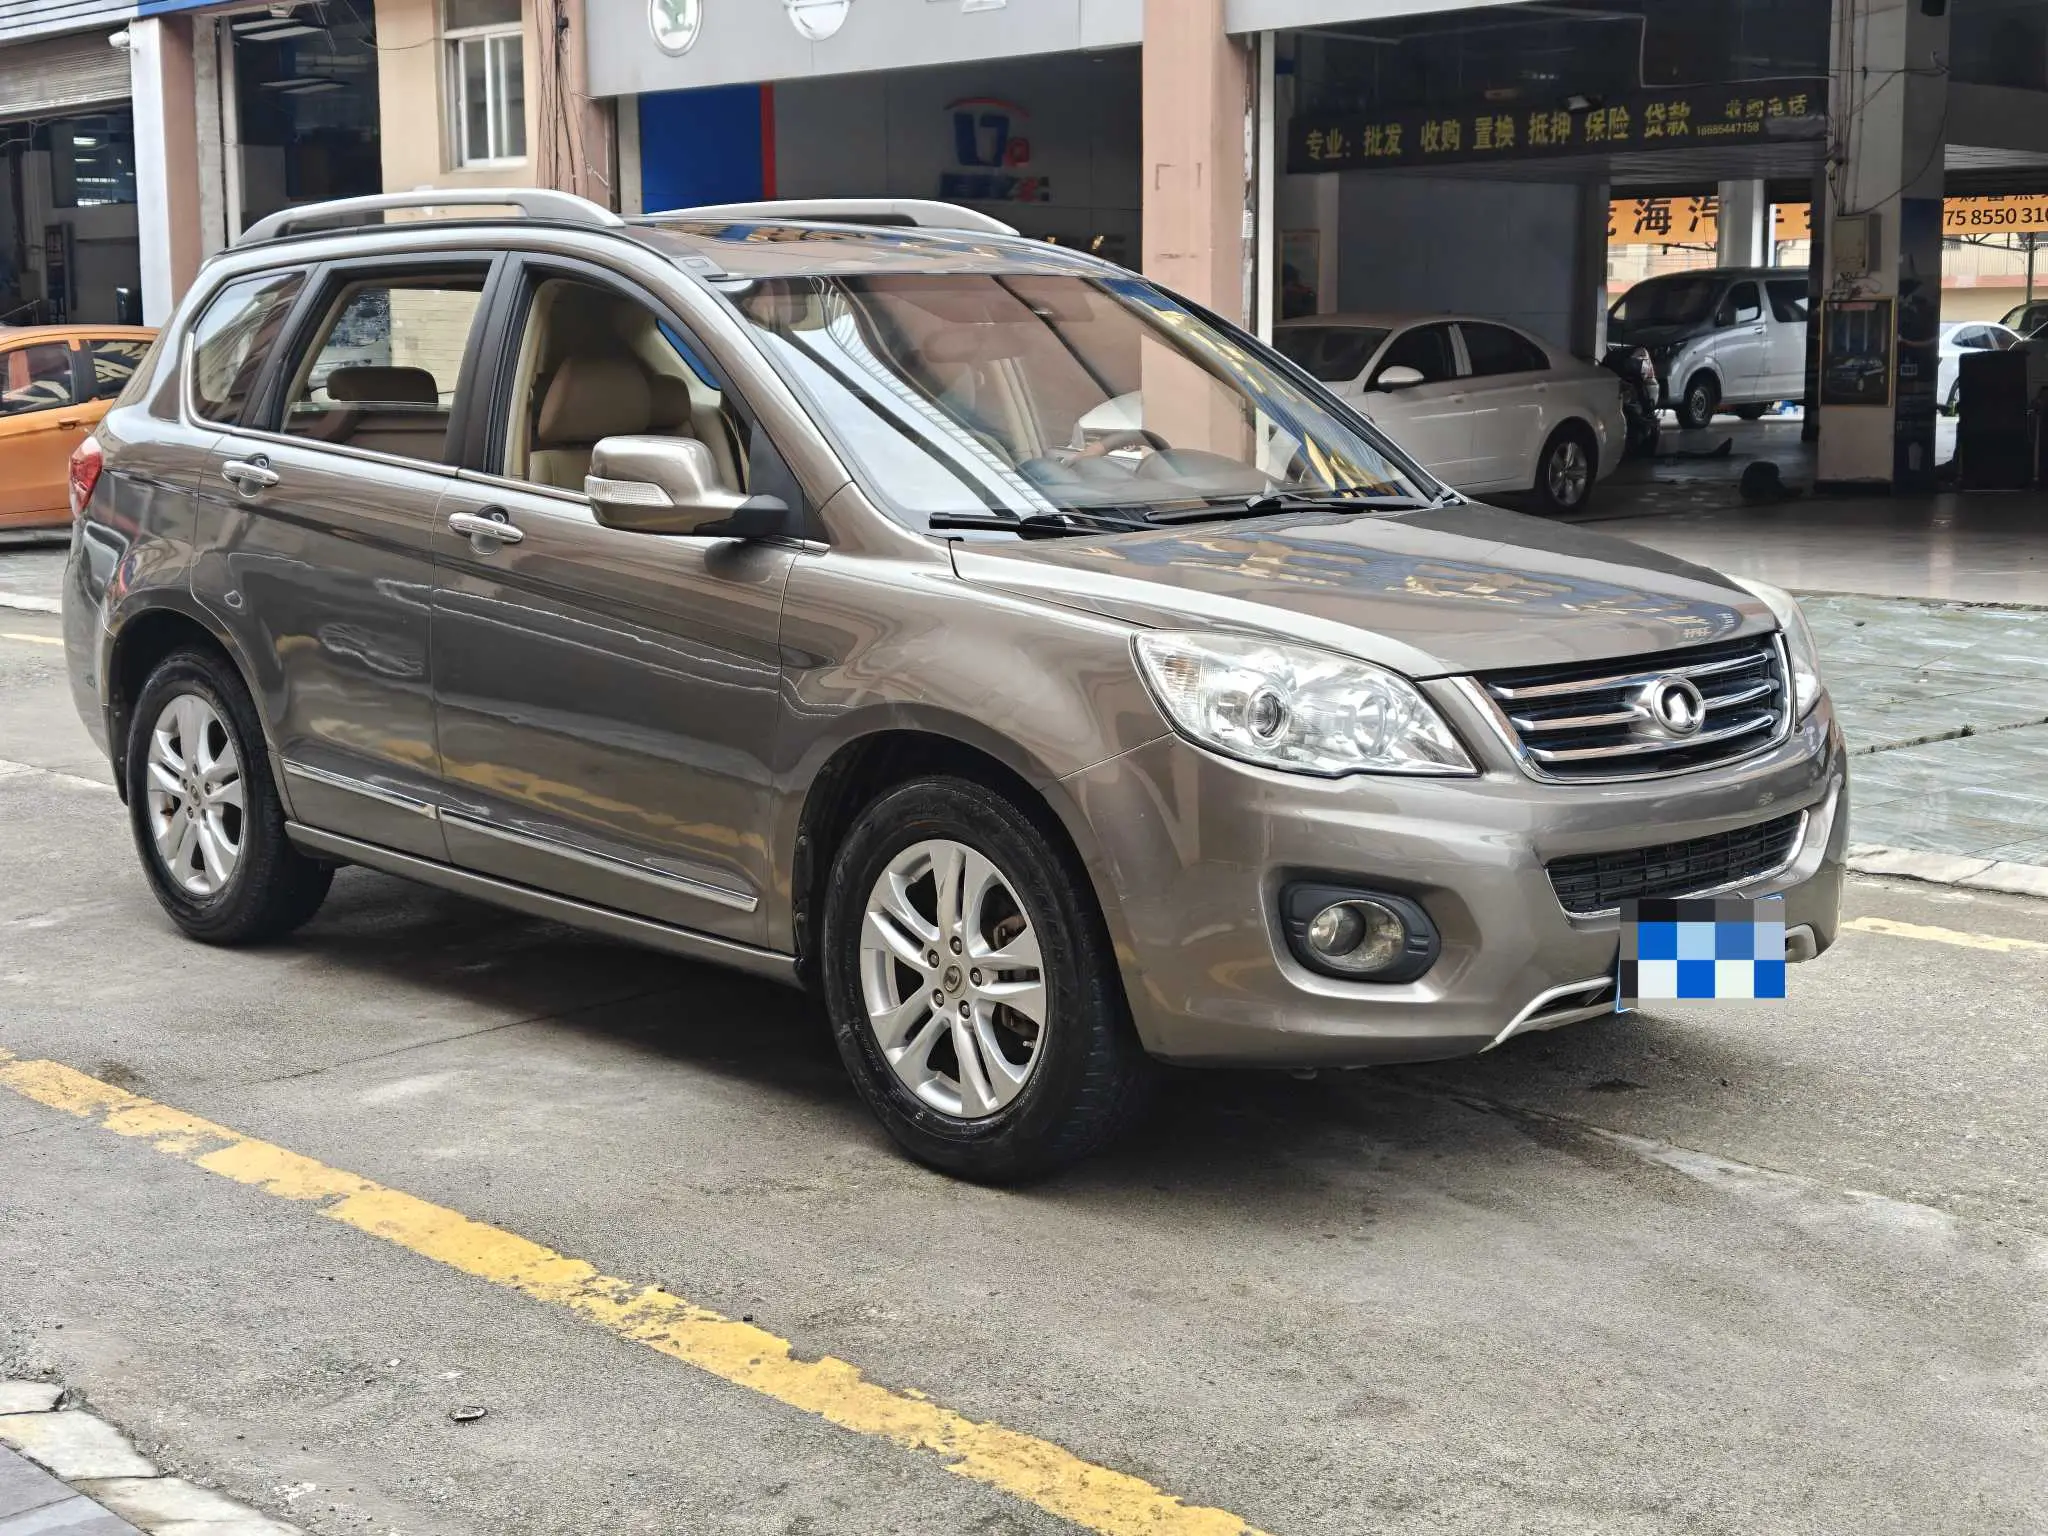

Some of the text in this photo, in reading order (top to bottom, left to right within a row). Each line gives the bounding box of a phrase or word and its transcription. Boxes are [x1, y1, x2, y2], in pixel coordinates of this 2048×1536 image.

[1363, 122, 1403, 157] 批发
[1420, 118, 1461, 152] 收购
[1472, 113, 1516, 149] 置换
[1527, 110, 1572, 145] 抵押
[1585, 105, 1631, 142] 保险
[1643, 101, 1692, 138] 贷款
[1608, 195, 1719, 237] 海汽
[1971, 207, 2018, 225] 8550
